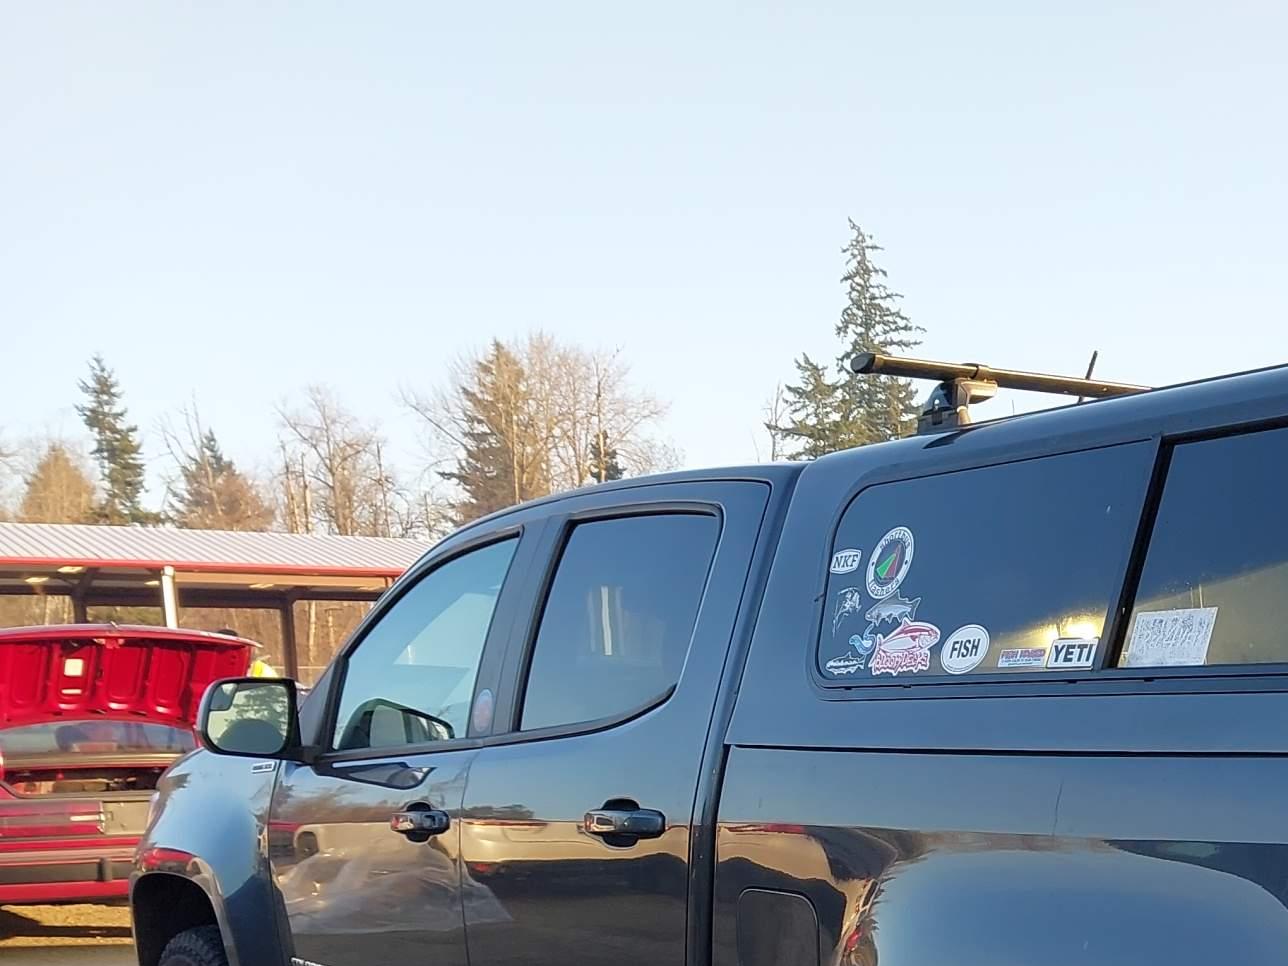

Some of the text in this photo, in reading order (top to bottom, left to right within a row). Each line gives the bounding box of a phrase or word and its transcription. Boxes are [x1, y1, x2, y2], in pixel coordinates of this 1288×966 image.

[832, 554, 859, 569] NKF
[949, 637, 981, 660] FISH
[1053, 643, 1097, 663] YETI
